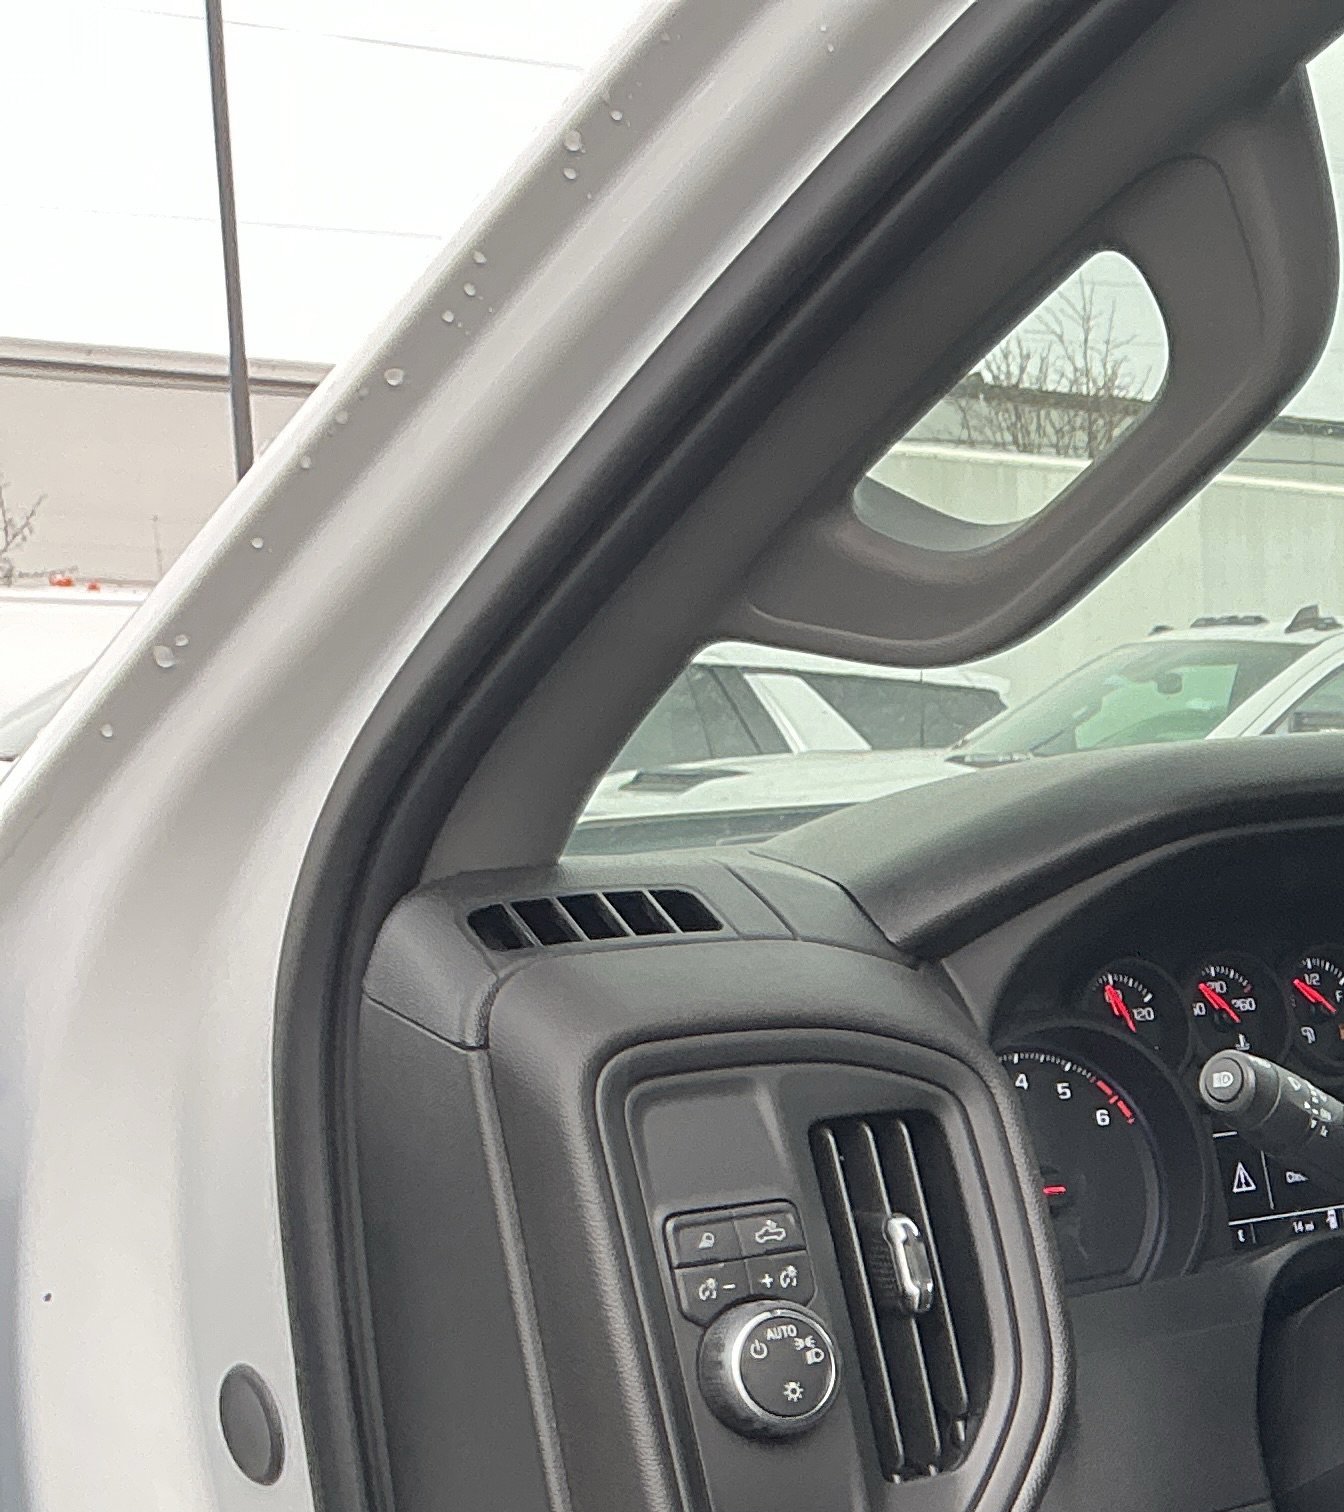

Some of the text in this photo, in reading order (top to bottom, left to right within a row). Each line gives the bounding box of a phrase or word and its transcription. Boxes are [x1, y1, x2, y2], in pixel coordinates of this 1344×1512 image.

[1015, 1073, 1029, 1091] 4
[1056, 1082, 1072, 1100] 5
[1095, 1109, 1110, 1128] 6
[766, 1325, 797, 1341] AUTO
